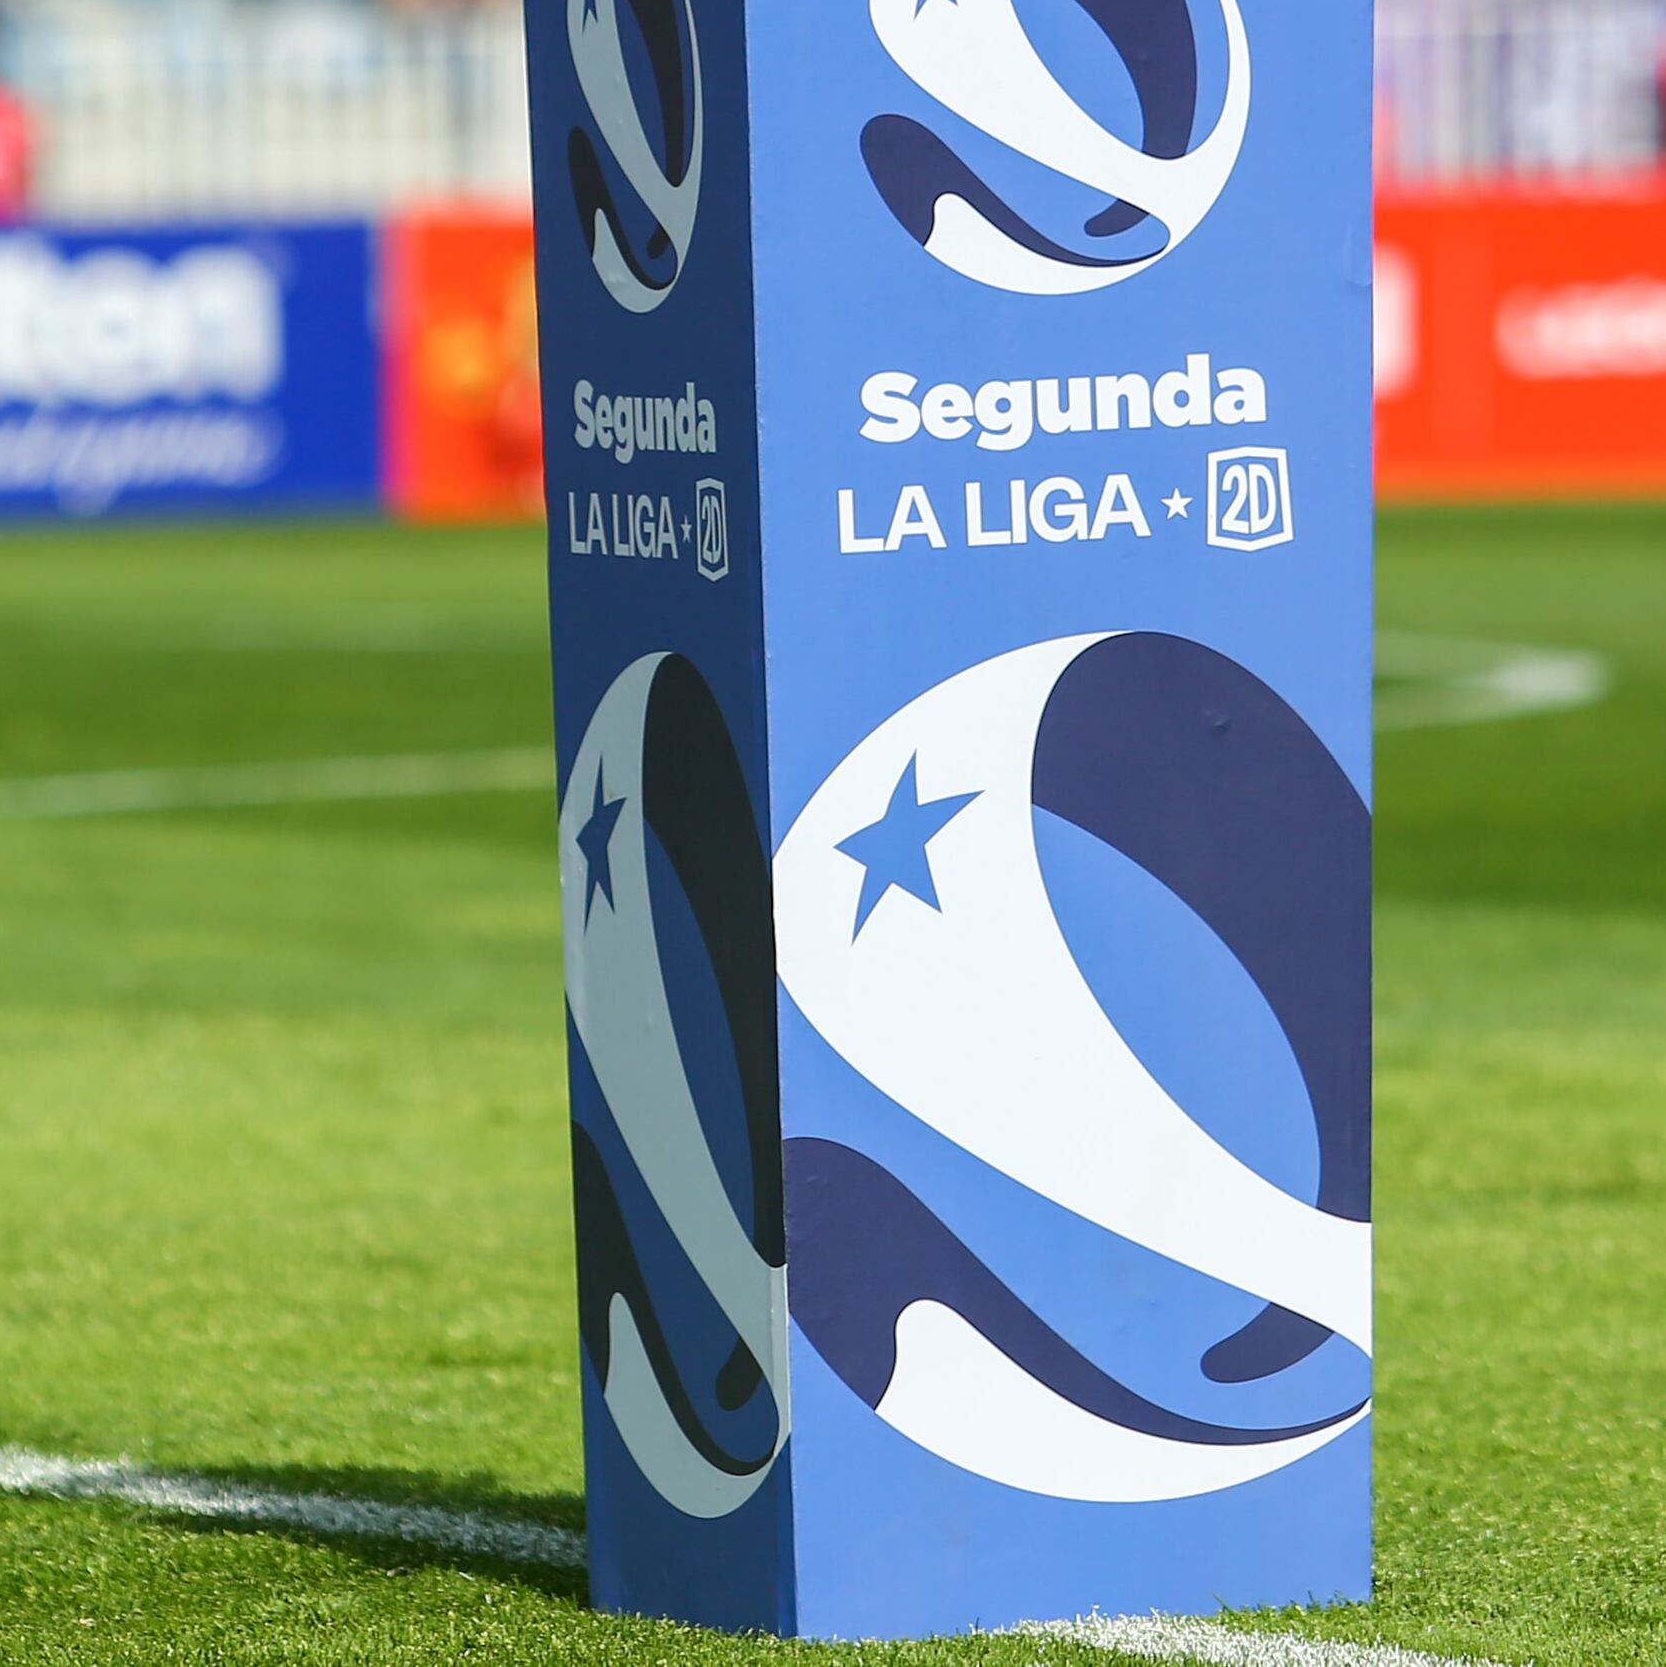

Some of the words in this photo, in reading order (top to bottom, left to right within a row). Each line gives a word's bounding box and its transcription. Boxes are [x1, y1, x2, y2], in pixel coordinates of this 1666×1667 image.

[574, 379, 716, 464] Segunda
[859, 353, 1267, 452] Segunda
[568, 492, 608, 555] LA
[612, 494, 679, 559] LIGA
[702, 495, 722, 564] 2D
[838, 485, 947, 554] LA
[965, 474, 1151, 547] LIGA
[1221, 463, 1277, 535] 2D
